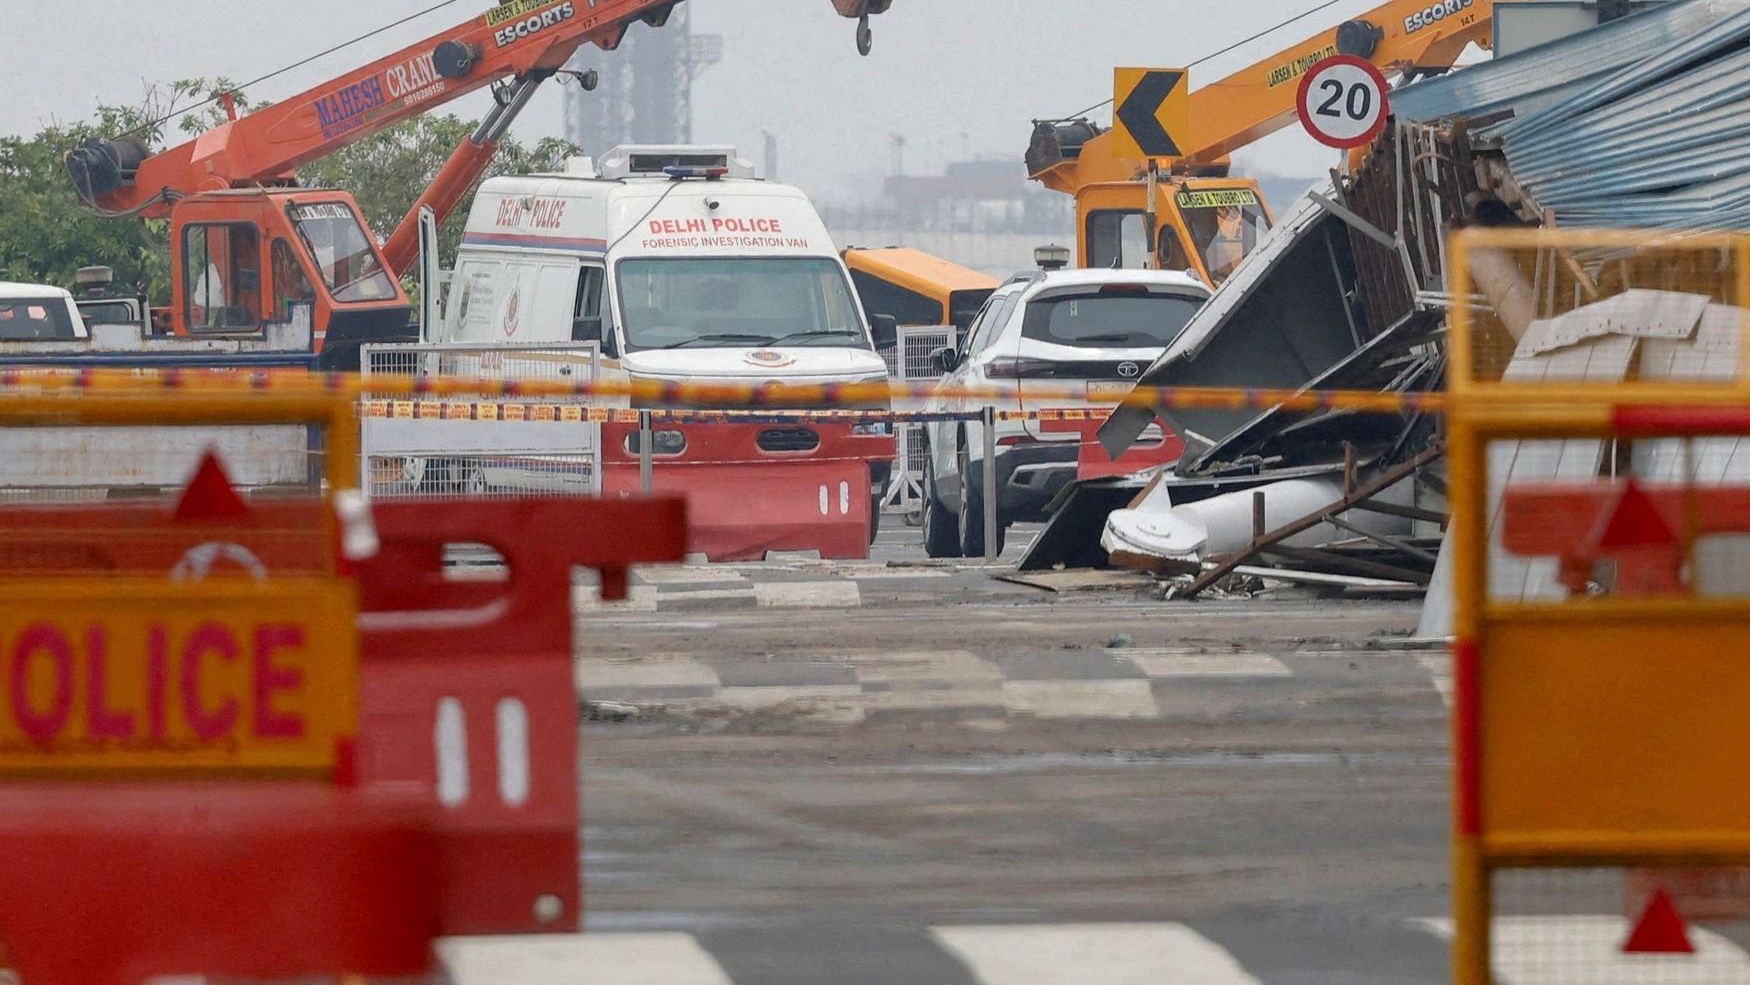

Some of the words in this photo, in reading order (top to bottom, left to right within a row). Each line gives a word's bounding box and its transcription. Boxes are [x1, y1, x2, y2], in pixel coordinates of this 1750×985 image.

[488, 4, 513, 26] LARSEN
[493, 0, 575, 48] ESCORTS
[1267, 64, 1291, 87] LARSEN
[314, 76, 386, 127] MAHESH
[1316, 79, 1371, 121] 20
[496, 197, 523, 227] DELHI
[530, 199, 566, 229] POLICE
[649, 219, 707, 234] DELHI
[712, 218, 782, 233] POLICE
[642, 236, 699, 249] FORENSIC
[701, 236, 784, 248] INVESTIGATION
[786, 238, 808, 249] VAN
